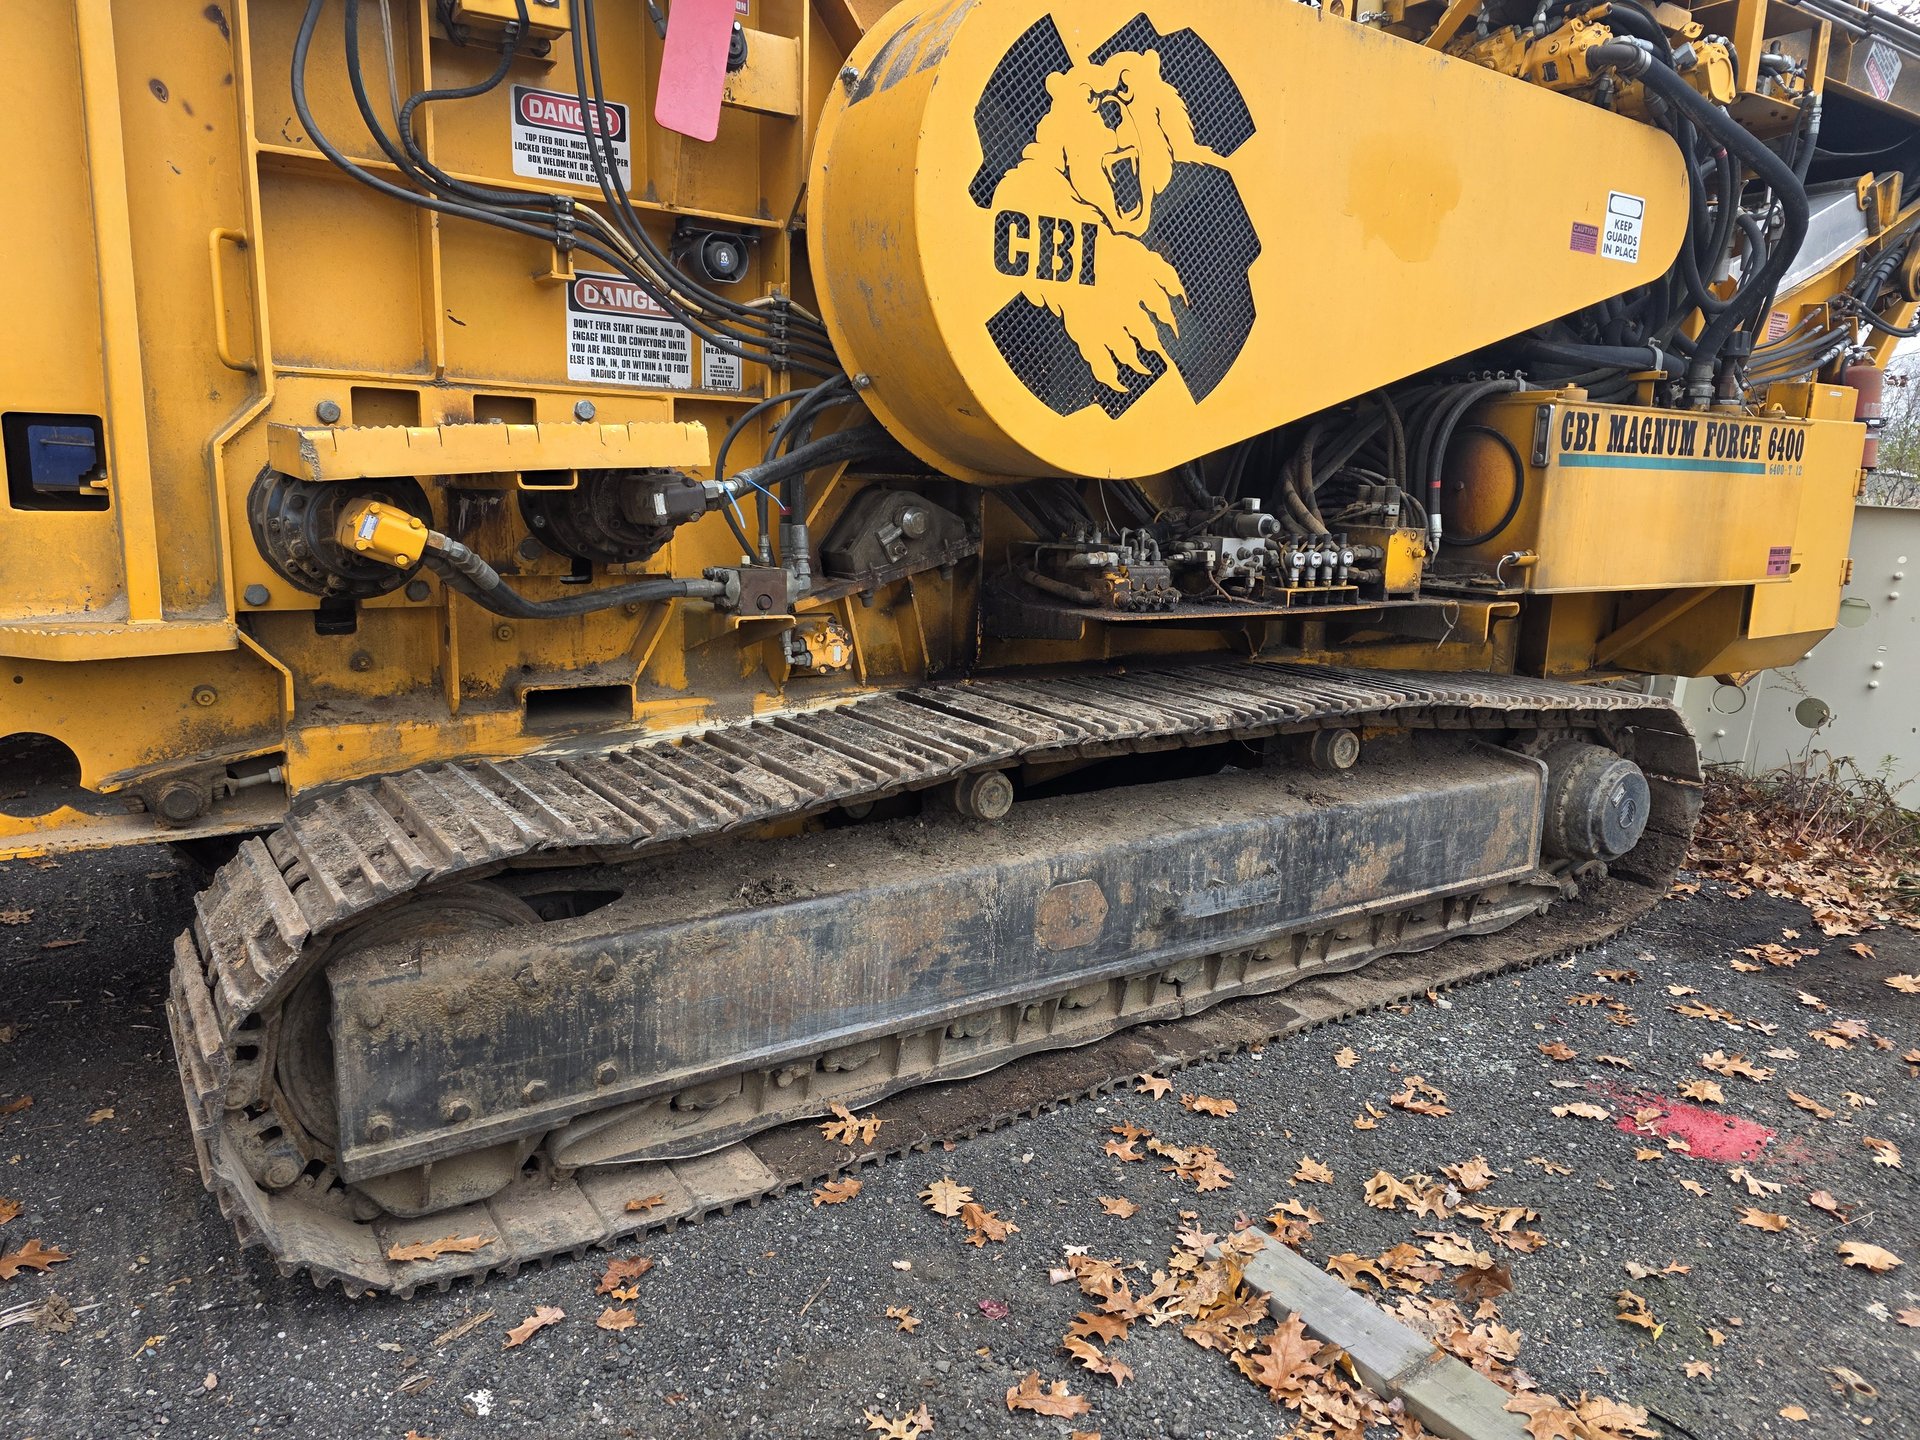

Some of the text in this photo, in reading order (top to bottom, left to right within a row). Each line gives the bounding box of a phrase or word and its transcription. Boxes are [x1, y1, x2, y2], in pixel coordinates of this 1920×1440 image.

[529, 98, 613, 131] DANGER
[515, 141, 540, 152] LOCKED
[542, 146, 565, 157] BEFORE
[525, 132, 537, 142] TOP
[539, 134, 552, 144] FEED
[554, 137, 568, 147] ROLL
[570, 140, 587, 150] MUST
[528, 154, 541, 164] BOX
[543, 156, 578, 169] WELDMENT
[580, 162, 588, 171] OR
[538, 166, 566, 178] DAMAGE
[568, 170, 584, 180] WILL
[1573, 224, 1598, 236] CAUTION
[1614, 219, 1633, 232] KEEP
[1606, 231, 1638, 246] GUARDS
[994, 210, 1098, 286] CBI
[1603, 243, 1637, 259] IN PLACE
[584, 284, 667, 312] DANGE
[574, 318, 684, 338] DON'T EVER START ENGINE AND/OR
[573, 331, 686, 350] ENGAGE MILL OR CONVEYORS UNTIL
[572, 343, 688, 362] YOU ARE ABSOLUTELY SURE NOBODY
[570, 354, 689, 374] ELSE IS ON, IN, OR WITHIN A 10 FOOT
[590, 368, 670, 384] RADIUS OF THE MACHINE
[1561, 410, 1804, 462] CBI MAGNUM FORCE 6400
